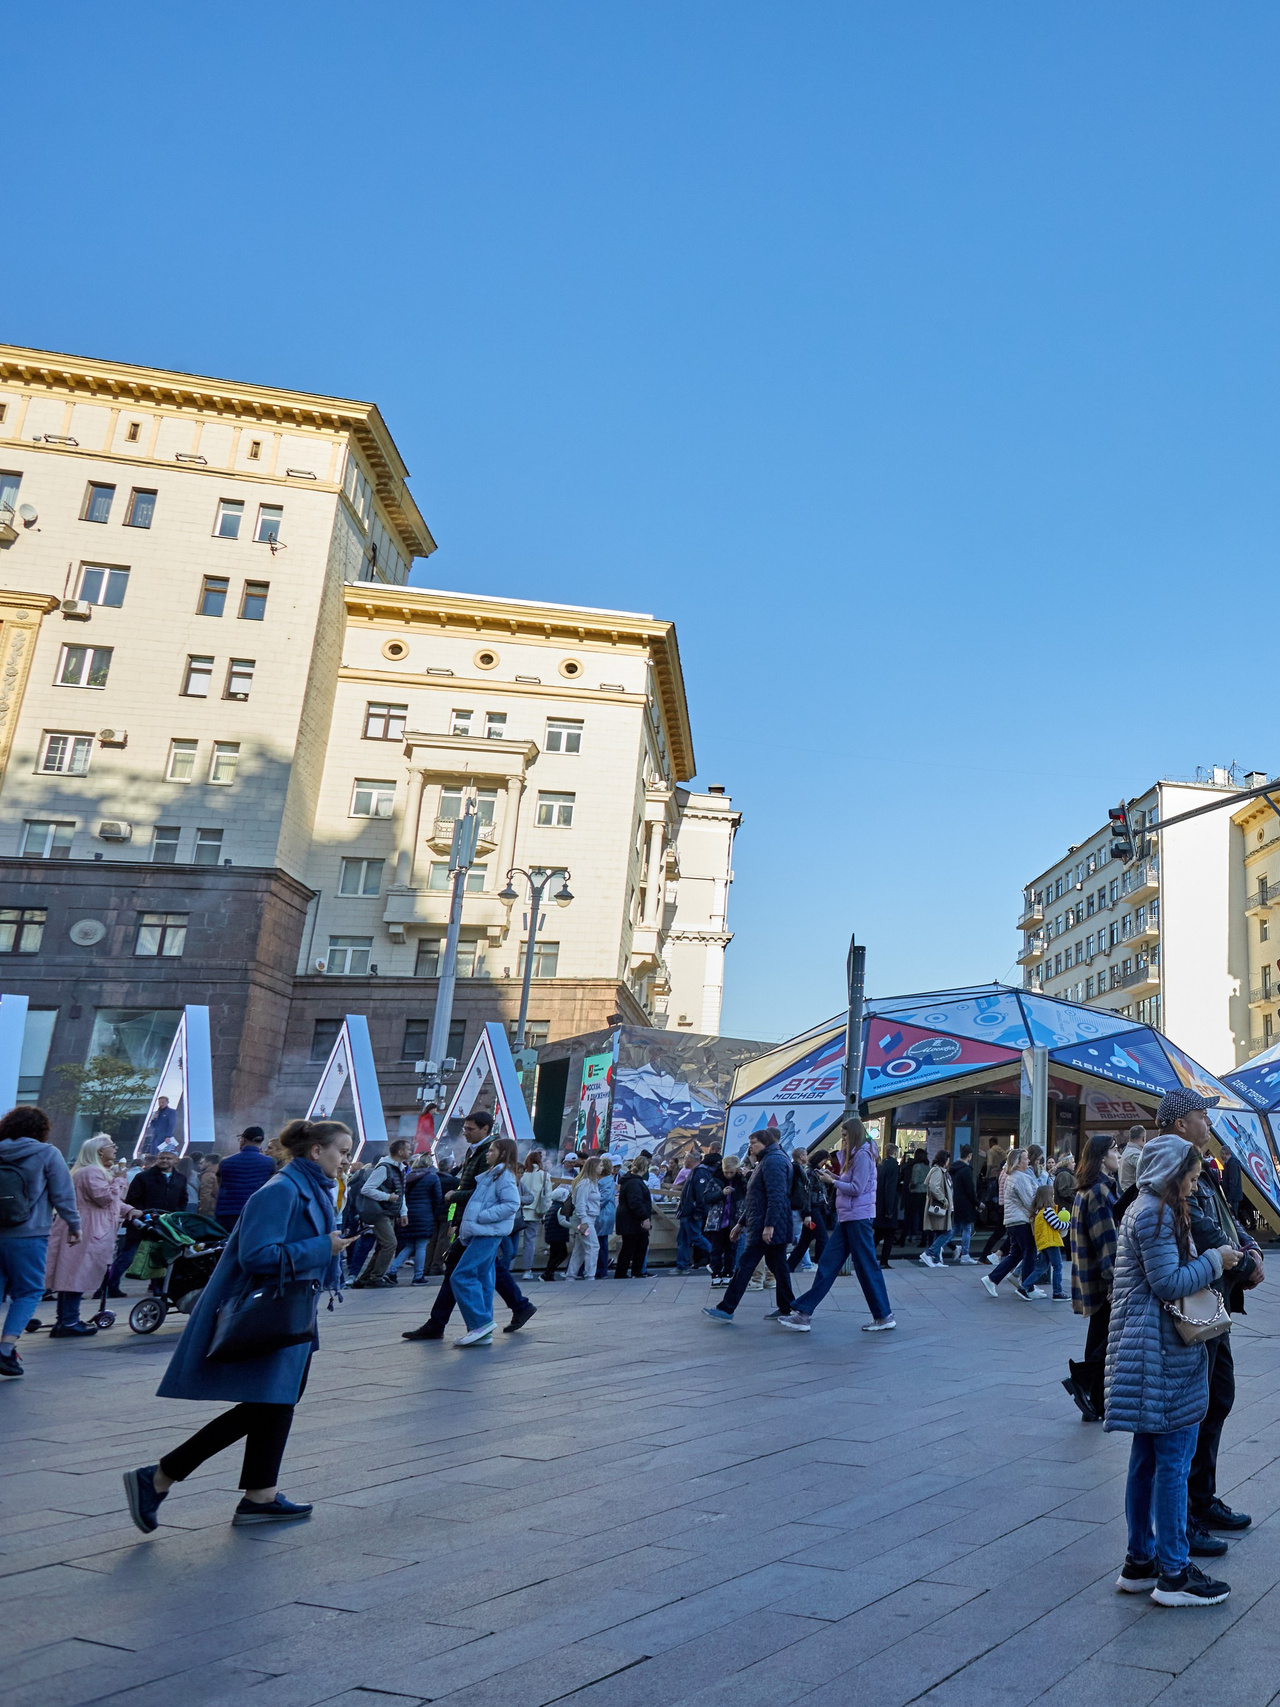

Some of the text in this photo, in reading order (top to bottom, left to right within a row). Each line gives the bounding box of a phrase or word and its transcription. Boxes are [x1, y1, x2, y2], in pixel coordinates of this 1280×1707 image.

[780, 1076, 839, 1091] 875
[1071, 1058, 1167, 1095] ДЕНЬ ГОРОД
[772, 1092, 826, 1100] МОСКВА
[1231, 1079, 1269, 1106] ДЕНЬ ГОРОДА
